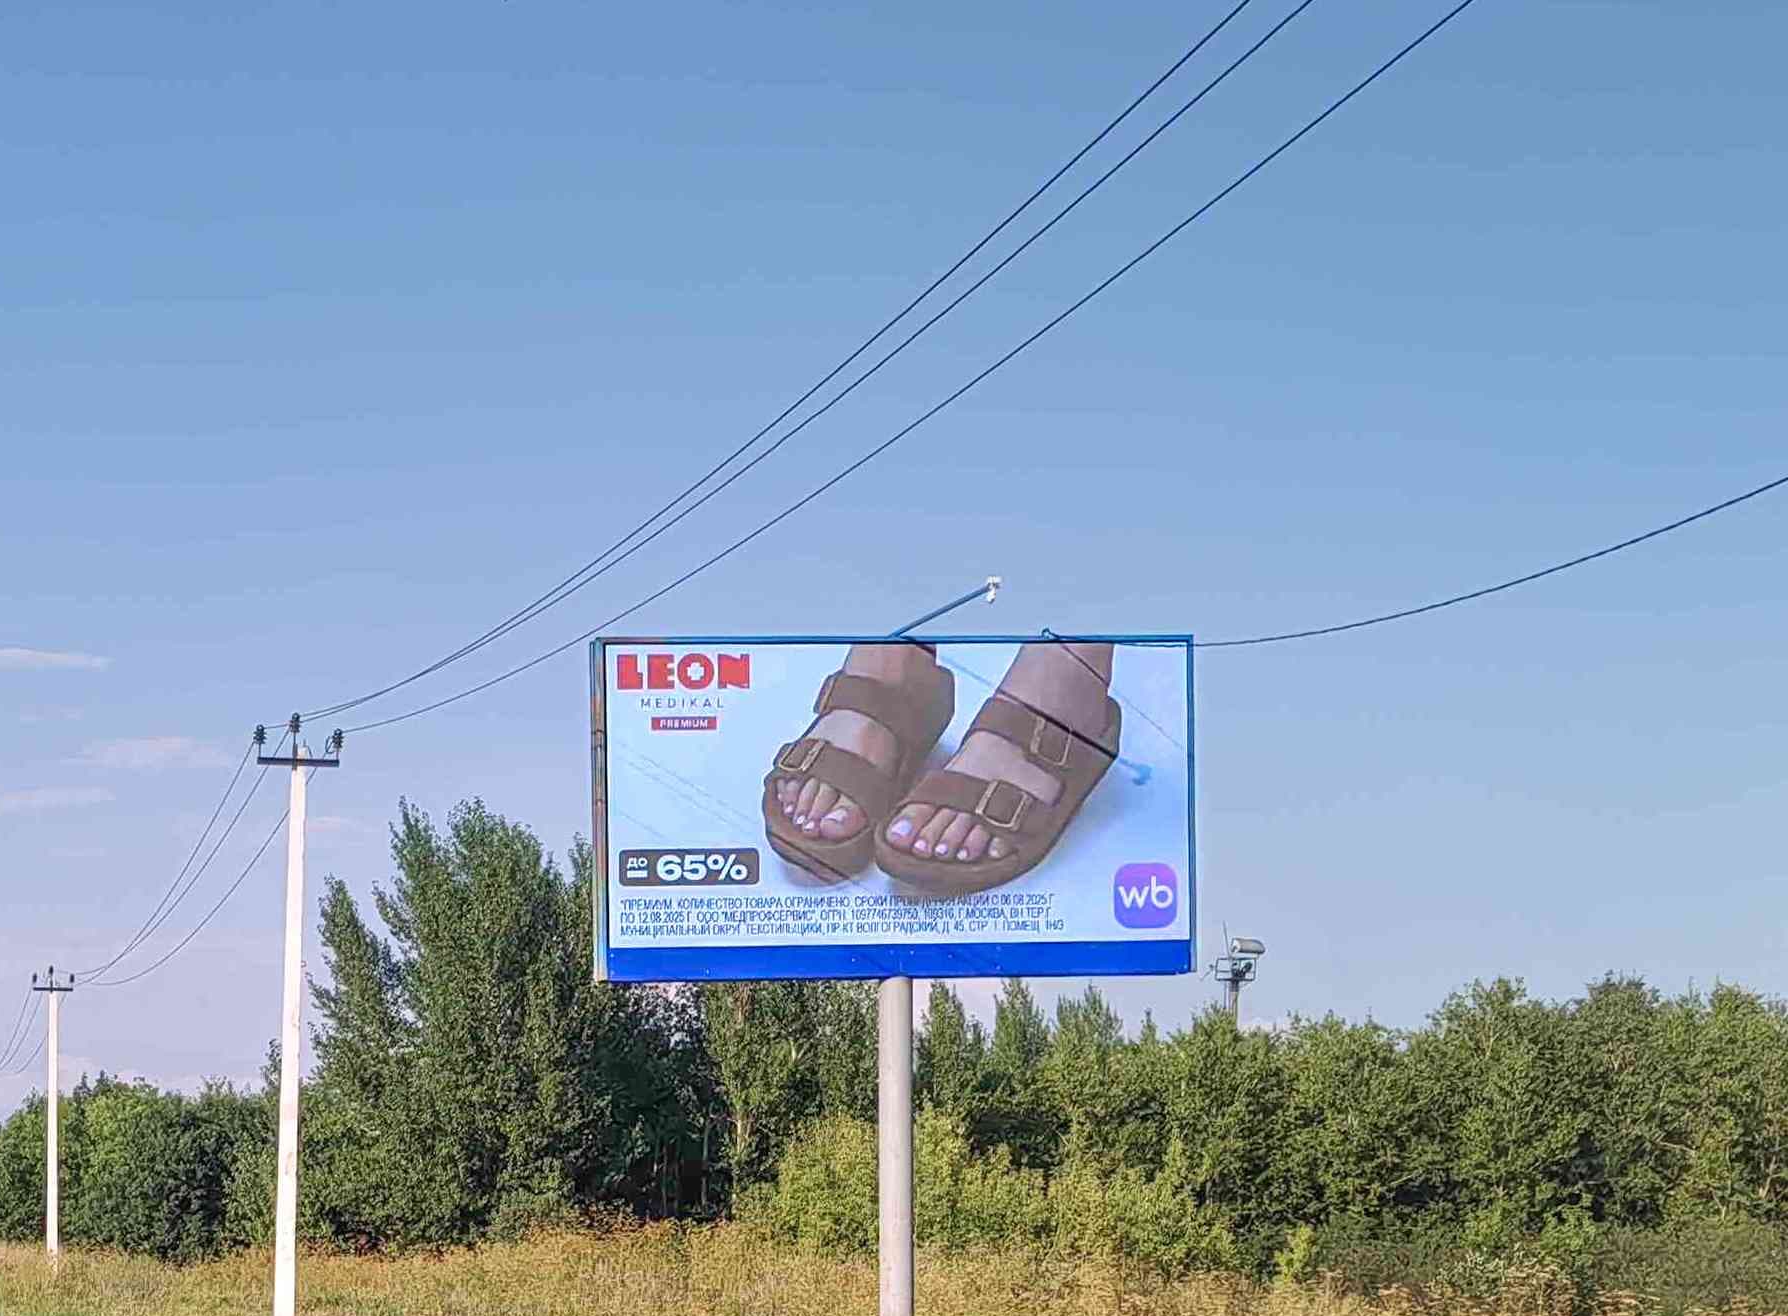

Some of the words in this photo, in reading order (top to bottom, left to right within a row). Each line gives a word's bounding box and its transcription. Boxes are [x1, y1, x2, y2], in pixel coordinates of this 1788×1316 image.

[617, 653, 750, 690] LEON
[640, 697, 725, 709] MEDIKAL
[659, 718, 709, 729] PREMIUM
[1117, 874, 1174, 909] wb
[677, 897, 742, 910] КОЛИЧЕСТВО
[743, 897, 783, 909] ТОВАРА
[620, 911, 635, 923] ПО
